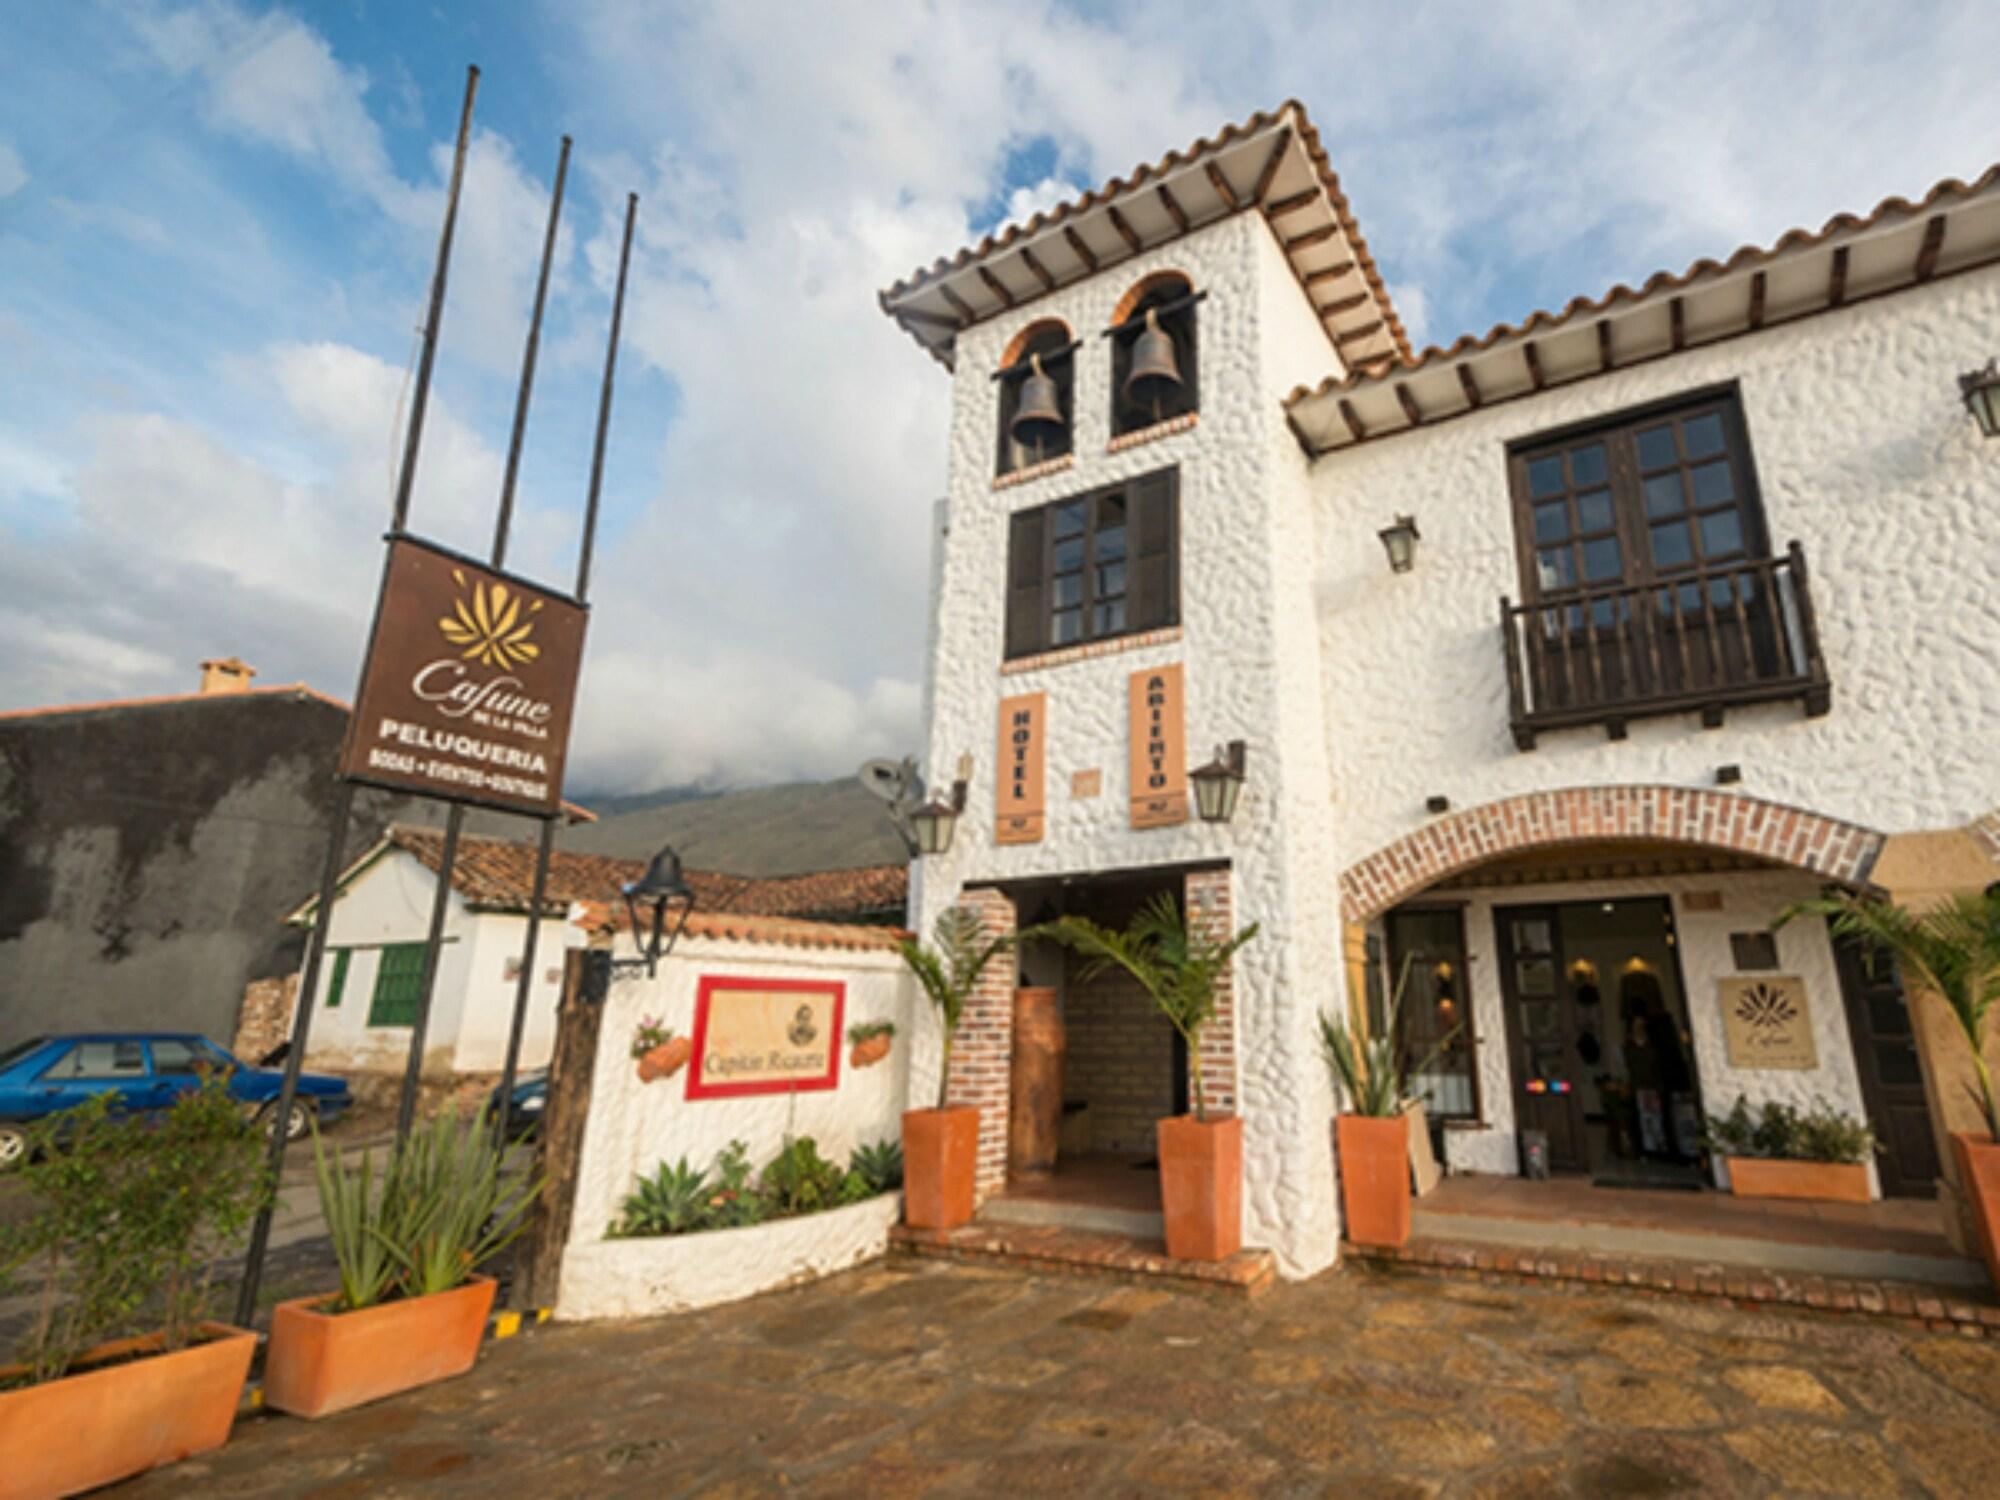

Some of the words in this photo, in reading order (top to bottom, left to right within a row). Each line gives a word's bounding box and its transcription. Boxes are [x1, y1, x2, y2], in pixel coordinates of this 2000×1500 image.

[379, 719, 546, 773] PELUQUERIA
[493, 715, 510, 729] LA
[1012, 710, 1030, 799] HOTEL
[1147, 676, 1166, 788] ABIERTO
